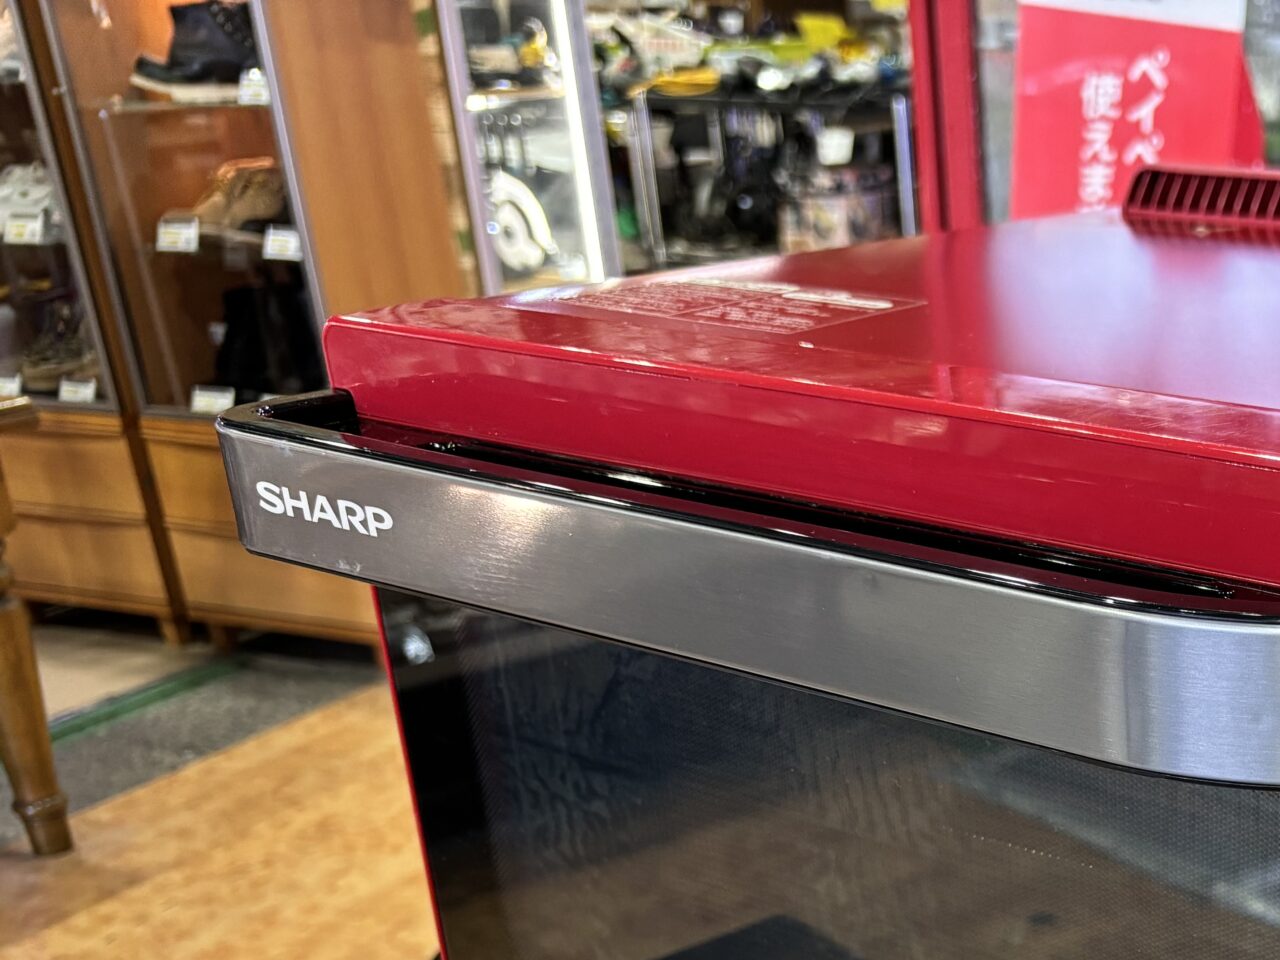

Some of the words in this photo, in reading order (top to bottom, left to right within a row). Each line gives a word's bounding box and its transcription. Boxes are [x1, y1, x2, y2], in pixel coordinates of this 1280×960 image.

[1078, 72, 1122, 212] 使えま
[256, 481, 393, 537] SHARP
